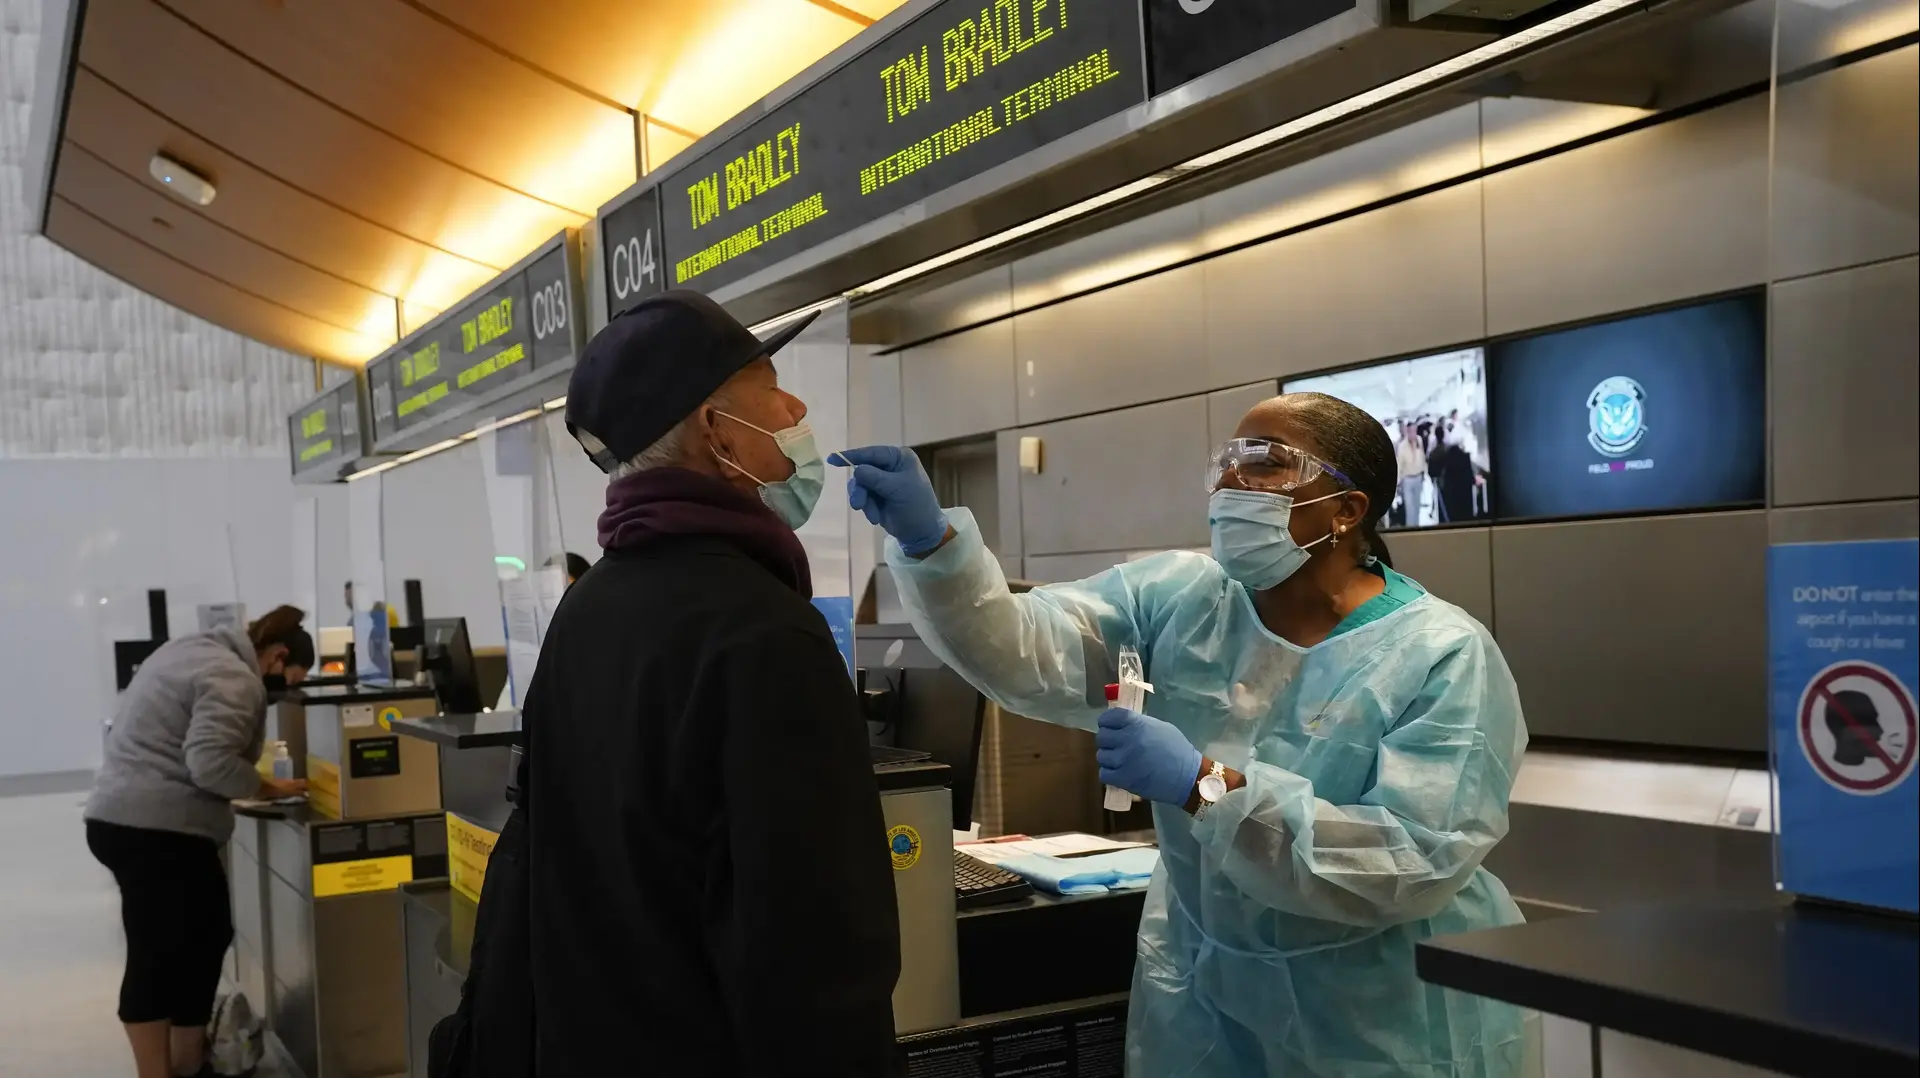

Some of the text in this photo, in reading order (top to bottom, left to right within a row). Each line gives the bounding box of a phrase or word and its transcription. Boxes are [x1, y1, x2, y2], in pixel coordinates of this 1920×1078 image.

[859, 48, 1120, 195] INTERNATIONAL TERMINAL
[880, 45, 931, 124] TOM
[687, 122, 801, 230] TOM BRADLEY
[613, 228, 656, 300] C04
[675, 192, 828, 284] INTERNATIONAL TERMINAL
[532, 280, 566, 340] C03
[1793, 586, 1820, 603] DO
[1821, 585, 1859, 602] NOT
